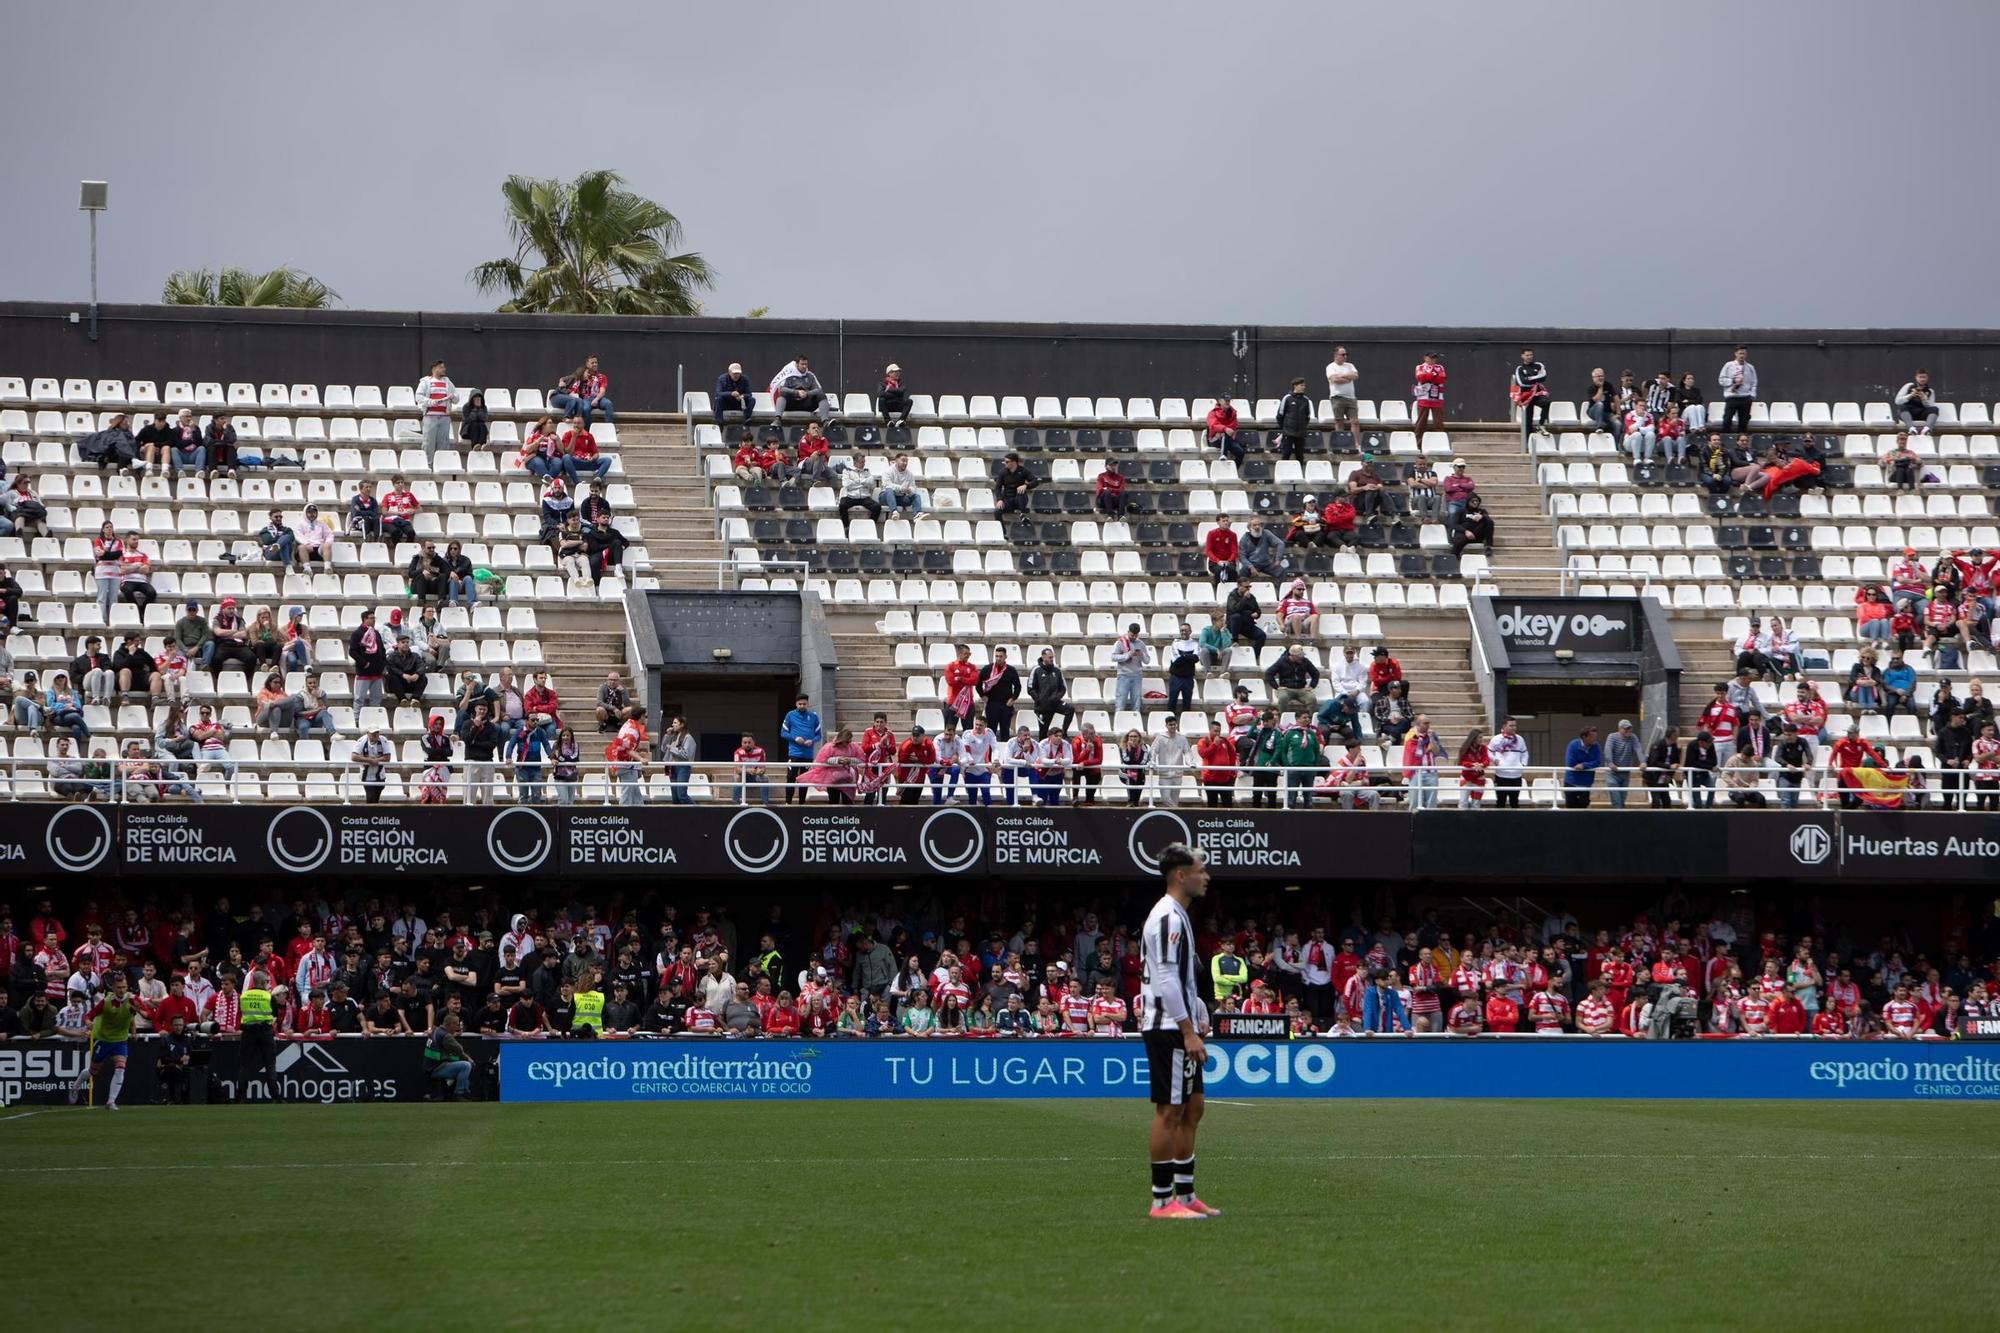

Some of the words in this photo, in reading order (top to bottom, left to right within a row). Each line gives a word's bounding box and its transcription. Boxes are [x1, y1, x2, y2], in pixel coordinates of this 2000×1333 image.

[1497, 606, 1566, 645] okey
[127, 815, 155, 823] Costa
[571, 816, 597, 824] Costa
[997, 817, 1026, 825] Costa
[1198, 819, 1224, 827] Costa
[127, 827, 202, 844] REGIÓN
[341, 827, 414, 845] REGIÓN
[571, 827, 643, 845] REGIÓN
[803, 828, 873, 845] REGIÓN
[996, 828, 1067, 845] REGIÓN
[1197, 830, 1268, 846] REGIÓN
[1789, 824, 1829, 862] MG
[1849, 835, 1938, 856] Huertas
[127, 847, 152, 862] DE
[158, 846, 236, 862] MURCIA
[341, 848, 365, 863] DE
[373, 848, 448, 864] MURCIA
[571, 848, 595, 862] DE
[602, 848, 677, 863] MURCIA
[803, 848, 826, 862] DE
[833, 847, 906, 863] MURCIA
[996, 848, 1020, 862] DE
[1027, 848, 1100, 864] MURCIA
[1199, 849, 1221, 865] DE
[1228, 850, 1301, 865] MURCIA
[1219, 1020, 1285, 1034] #FANCAM
[528, 1057, 625, 1087] espacio
[632, 1053, 811, 1080] mediterráneo
[885, 1058, 932, 1084] TU
[953, 1058, 1084, 1084] LUGAR
[1104, 1056, 1149, 1085] DE
[1203, 1043, 1337, 1085] OCIO
[1810, 1058, 1908, 1087] espacio
[25, 1081, 57, 1091] Design
[58, 1081, 66, 1090] &
[632, 1083, 678, 1093] CENTRO
[682, 1083, 747, 1093] COMERCIAL
[751, 1083, 757, 1092] Y
[762, 1083, 777, 1093] DE
[779, 1082, 812, 1093] OCIO
[1914, 1084, 1961, 1094] CENTRO
